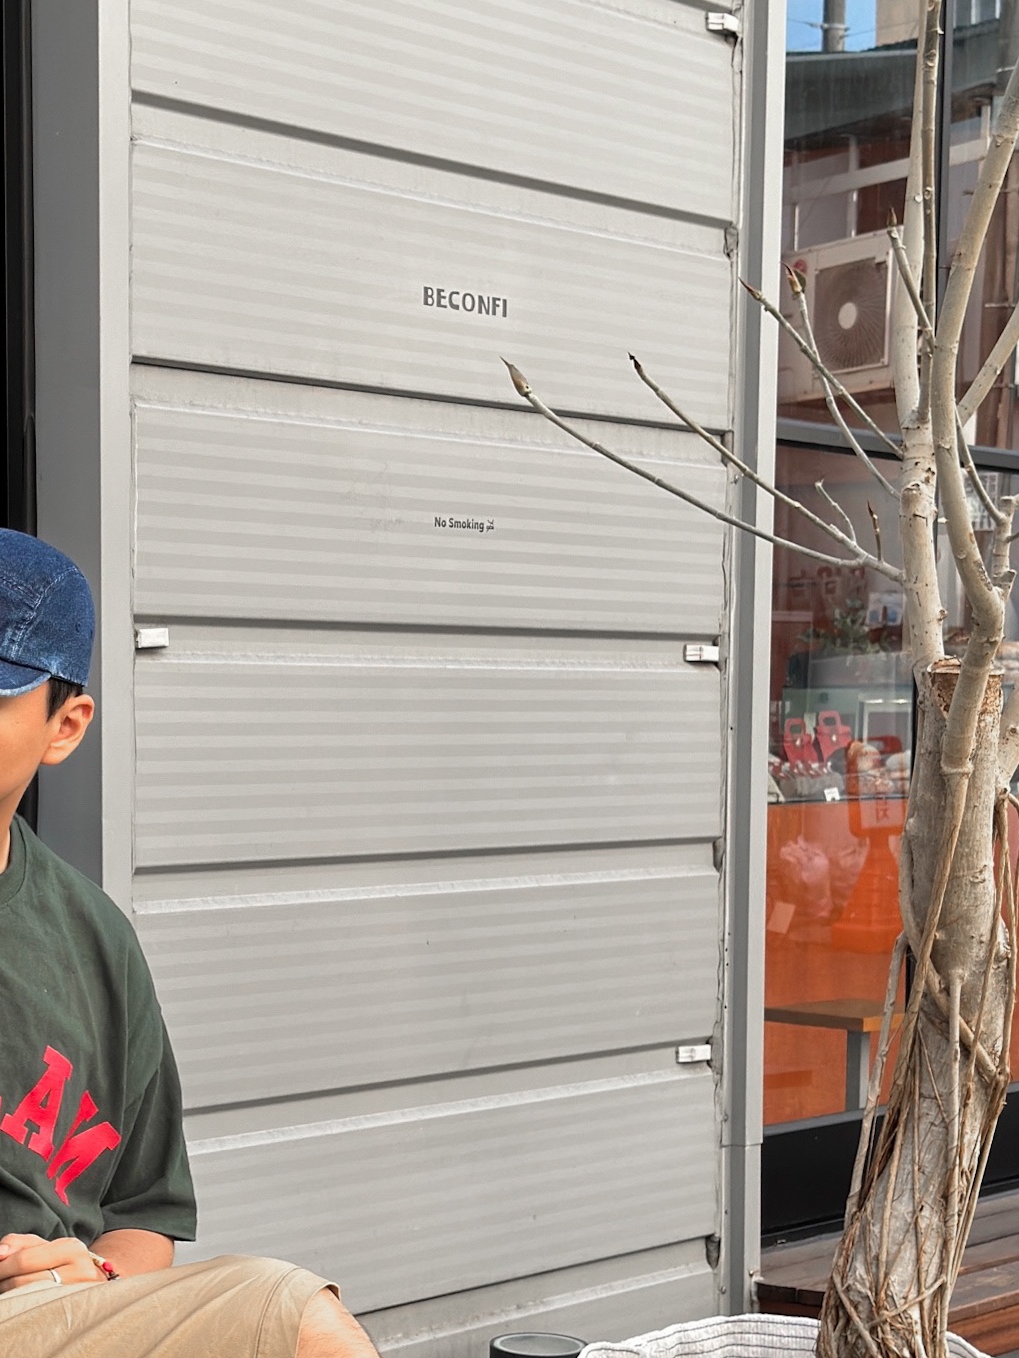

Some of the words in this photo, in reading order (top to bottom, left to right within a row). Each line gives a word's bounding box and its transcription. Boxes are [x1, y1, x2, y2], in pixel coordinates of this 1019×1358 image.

[423, 286, 508, 318] BECONFI
[434, 516, 447, 528] No
[448, 517, 485, 533] Smoking
